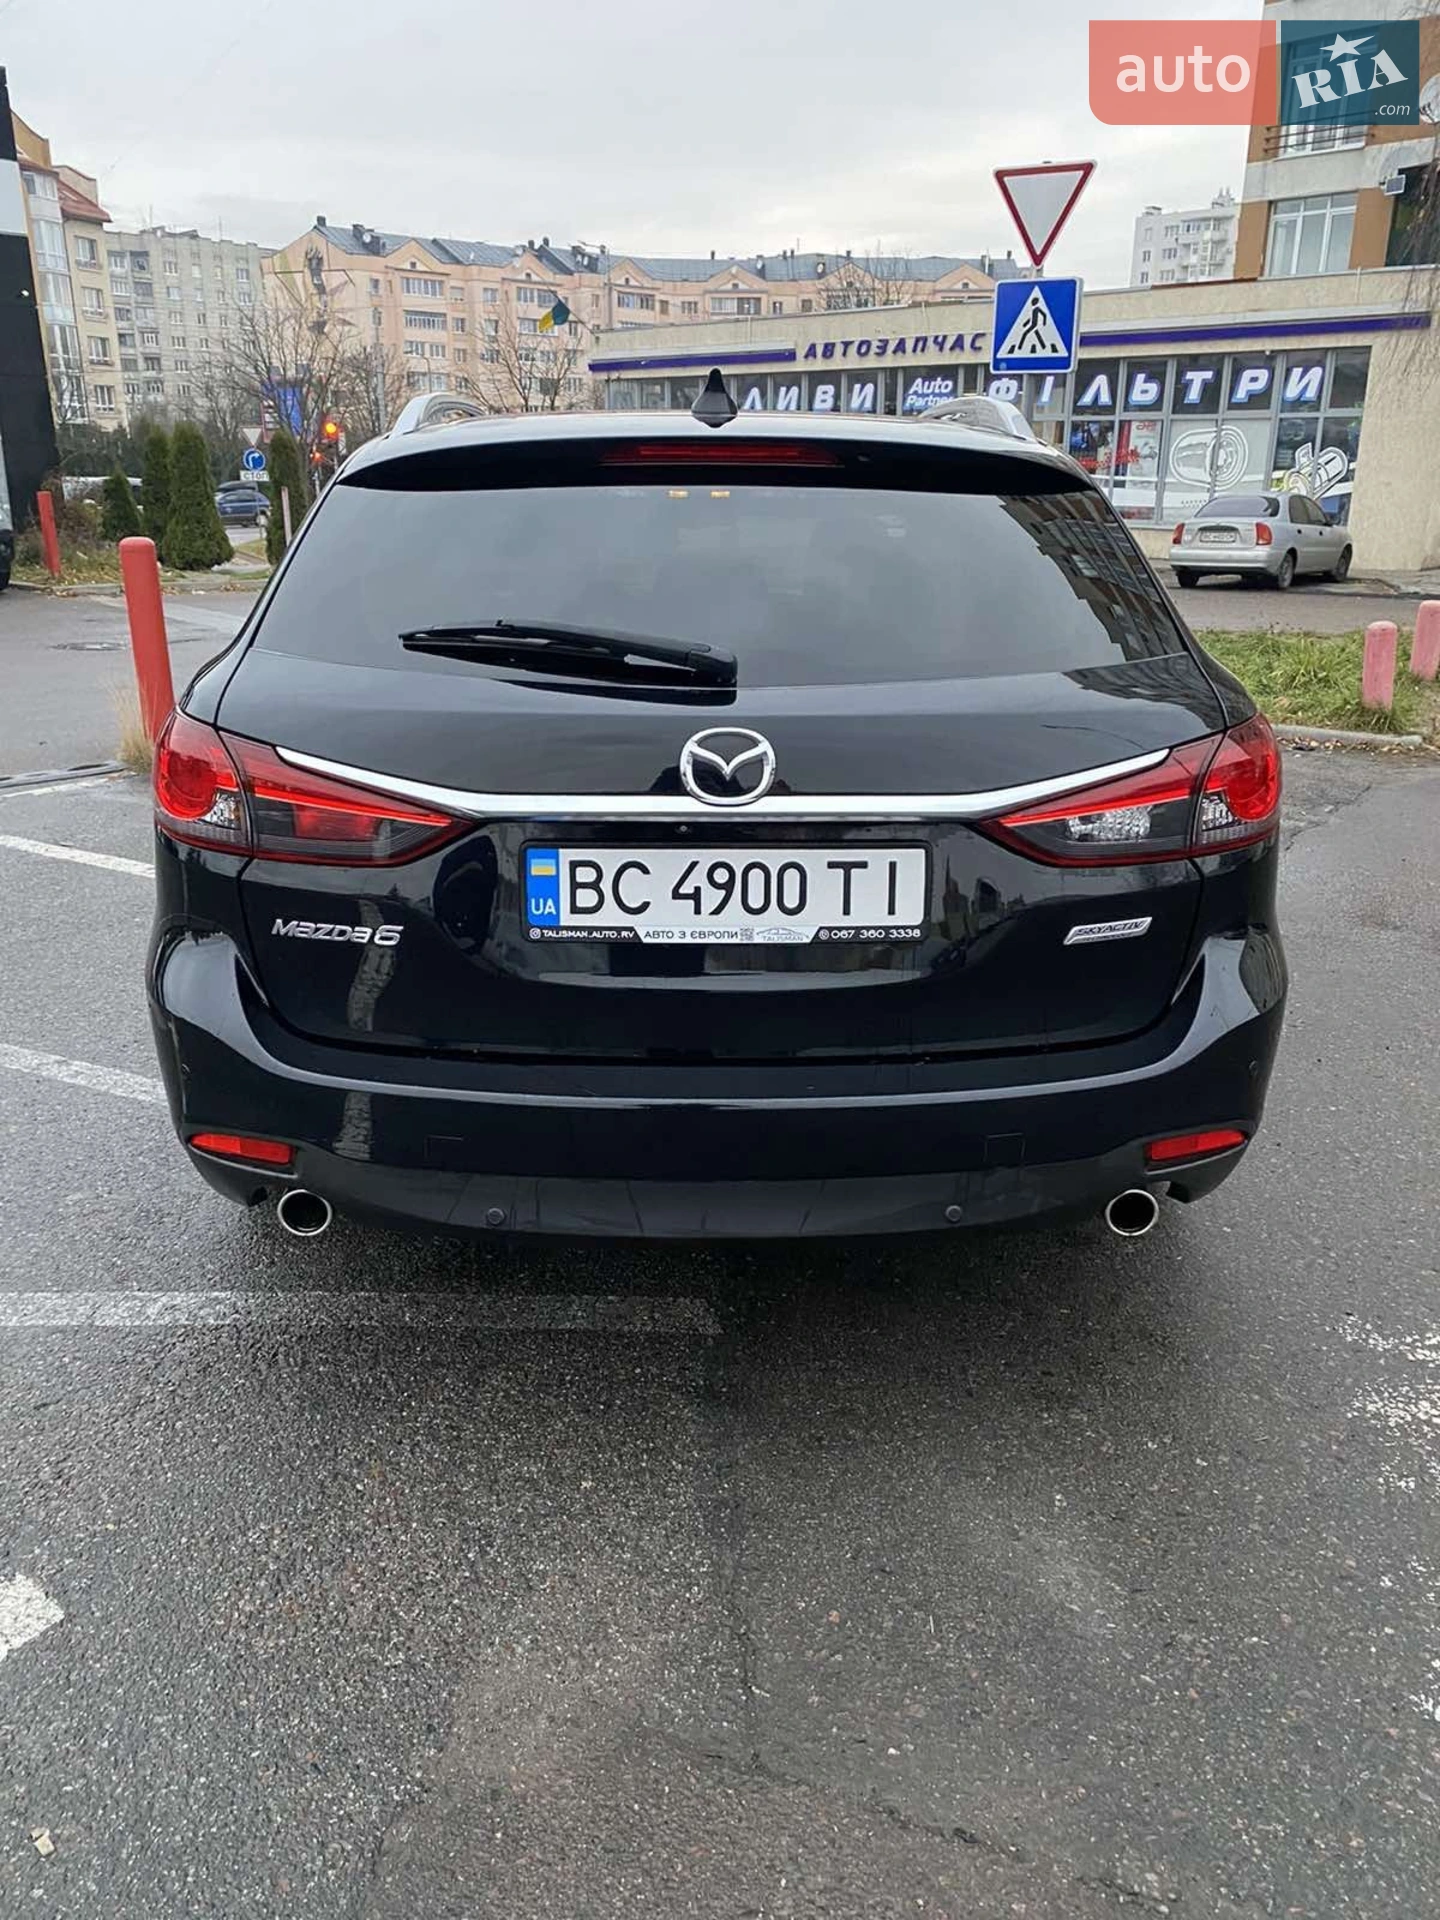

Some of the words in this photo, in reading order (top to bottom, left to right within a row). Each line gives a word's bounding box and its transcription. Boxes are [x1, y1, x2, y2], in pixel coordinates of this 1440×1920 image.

[803, 331, 988, 360] АВТОЗАПЧАС
[743, 382, 876, 411] ЛИВИ
[908, 377, 954, 394] Auto
[988, 365, 1325, 408] ФІЛЬТРИ
[568, 859, 652, 916] BC
[671, 859, 808, 917] 4900
[826, 860, 898, 916] TI
[531, 897, 557, 915] UA
[643, 930, 674, 939] АВТО
[690, 930, 739, 939] ЄВРОПИ
[830, 929, 855, 939] 067
[859, 929, 886, 939] 360
